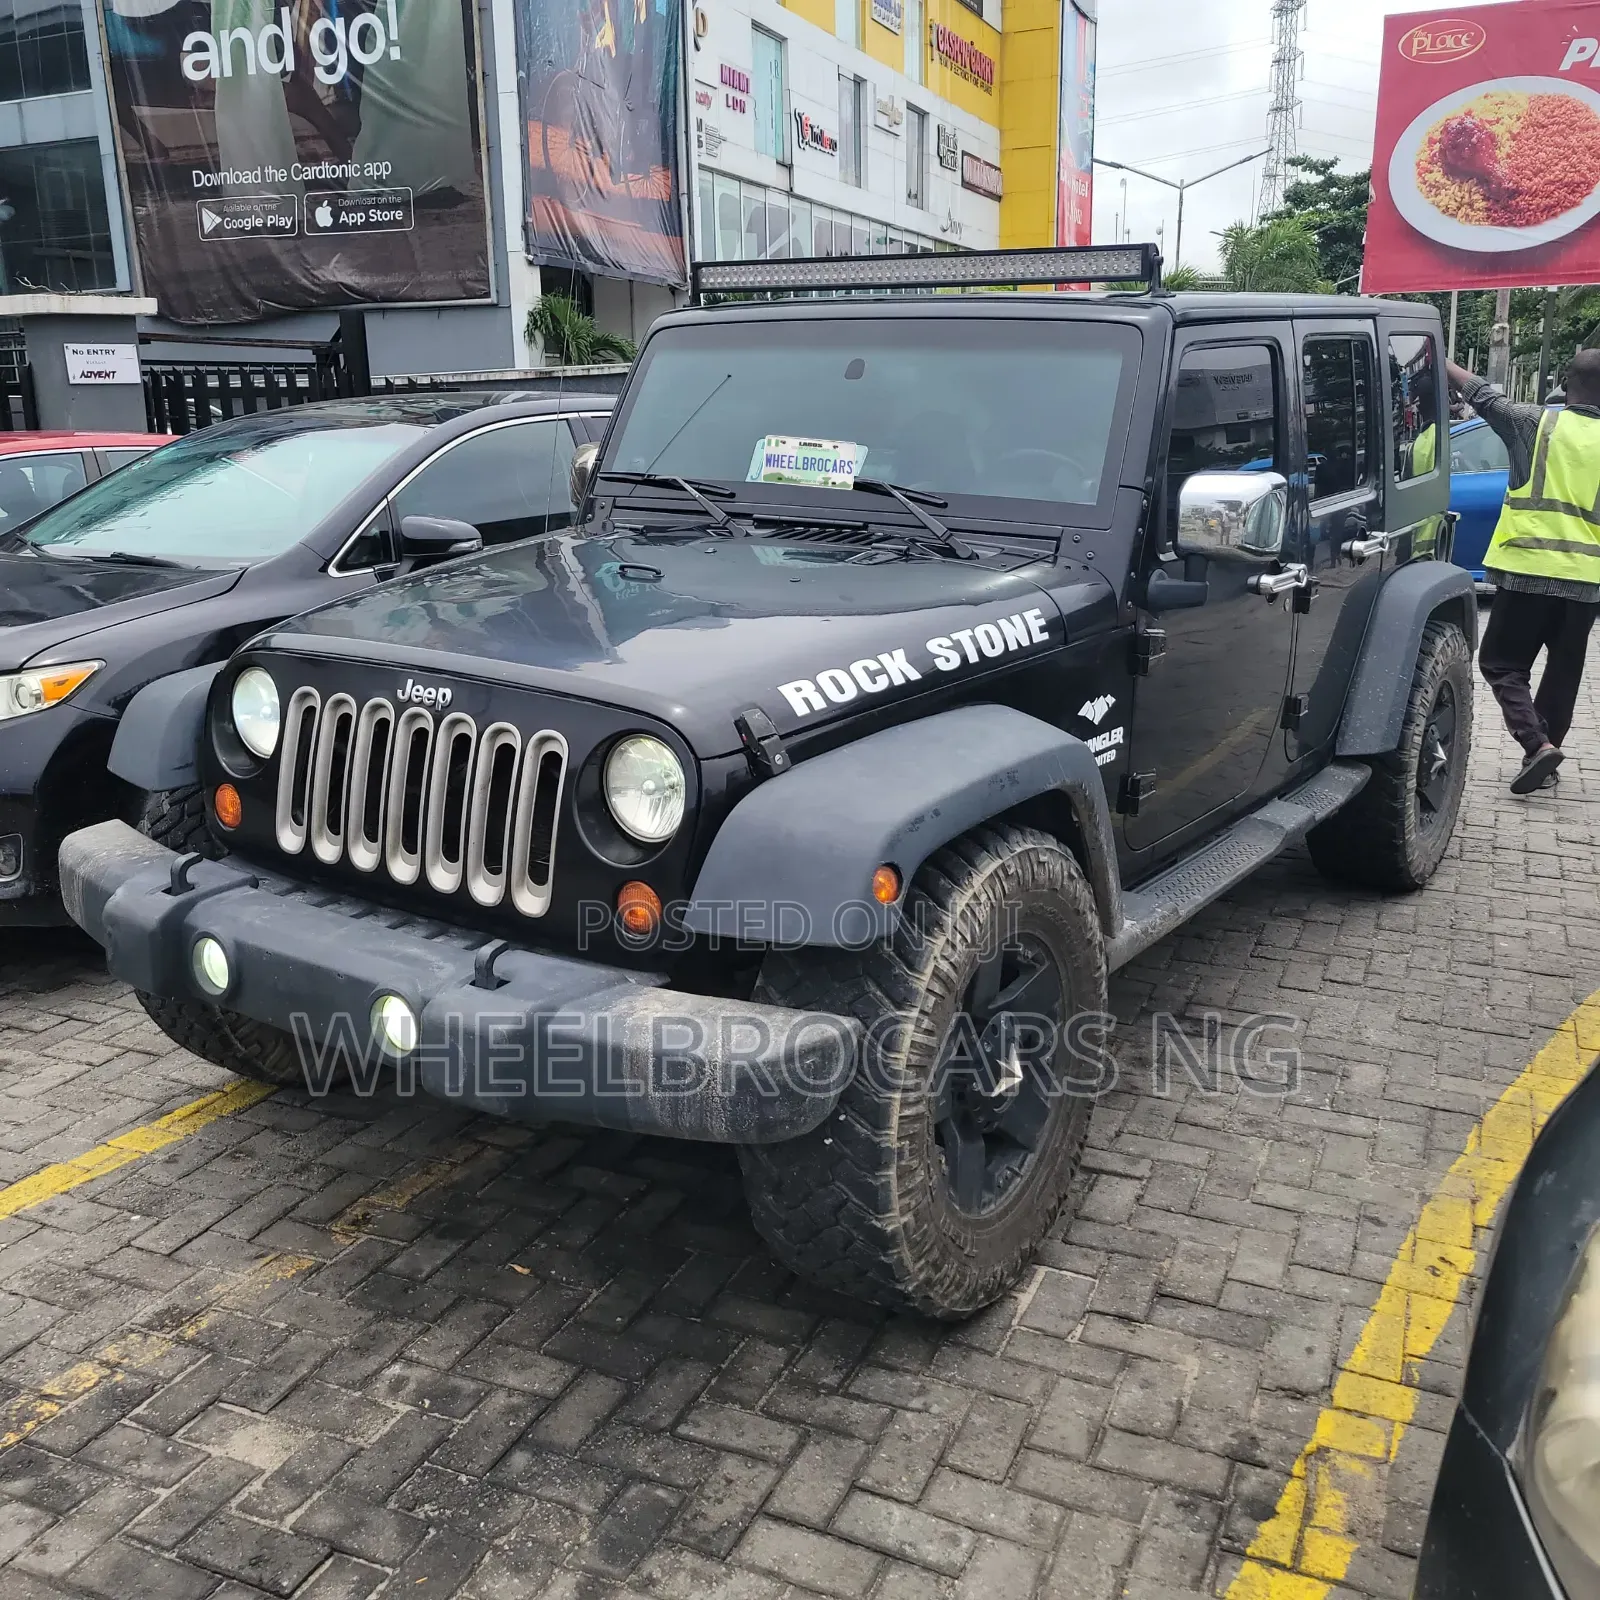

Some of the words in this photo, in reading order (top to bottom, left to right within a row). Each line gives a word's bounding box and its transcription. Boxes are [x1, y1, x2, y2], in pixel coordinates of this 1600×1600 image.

[182, 7, 295, 81] and
[309, 0, 401, 84] go!
[720, 63, 750, 94] MIAMI
[192, 164, 262, 187] Download
[264, 165, 287, 183] the
[291, 160, 361, 181] Cardtonic
[364, 161, 392, 180] app
[338, 197, 376, 207] Download
[378, 197, 387, 205] on
[388, 195, 402, 204] the
[223, 215, 263, 231] Google
[267, 214, 293, 229] Play
[339, 211, 365, 225] App
[368, 209, 403, 222] Store
[87, 348, 116, 356] ENTRY
[80, 369, 117, 379] ADVENT
[765, 453, 854, 475] WHEELBROCARS
[777, 648, 922, 717] ROCK
[925, 608, 1049, 672] STONE
[396, 678, 453, 711] Jeep
